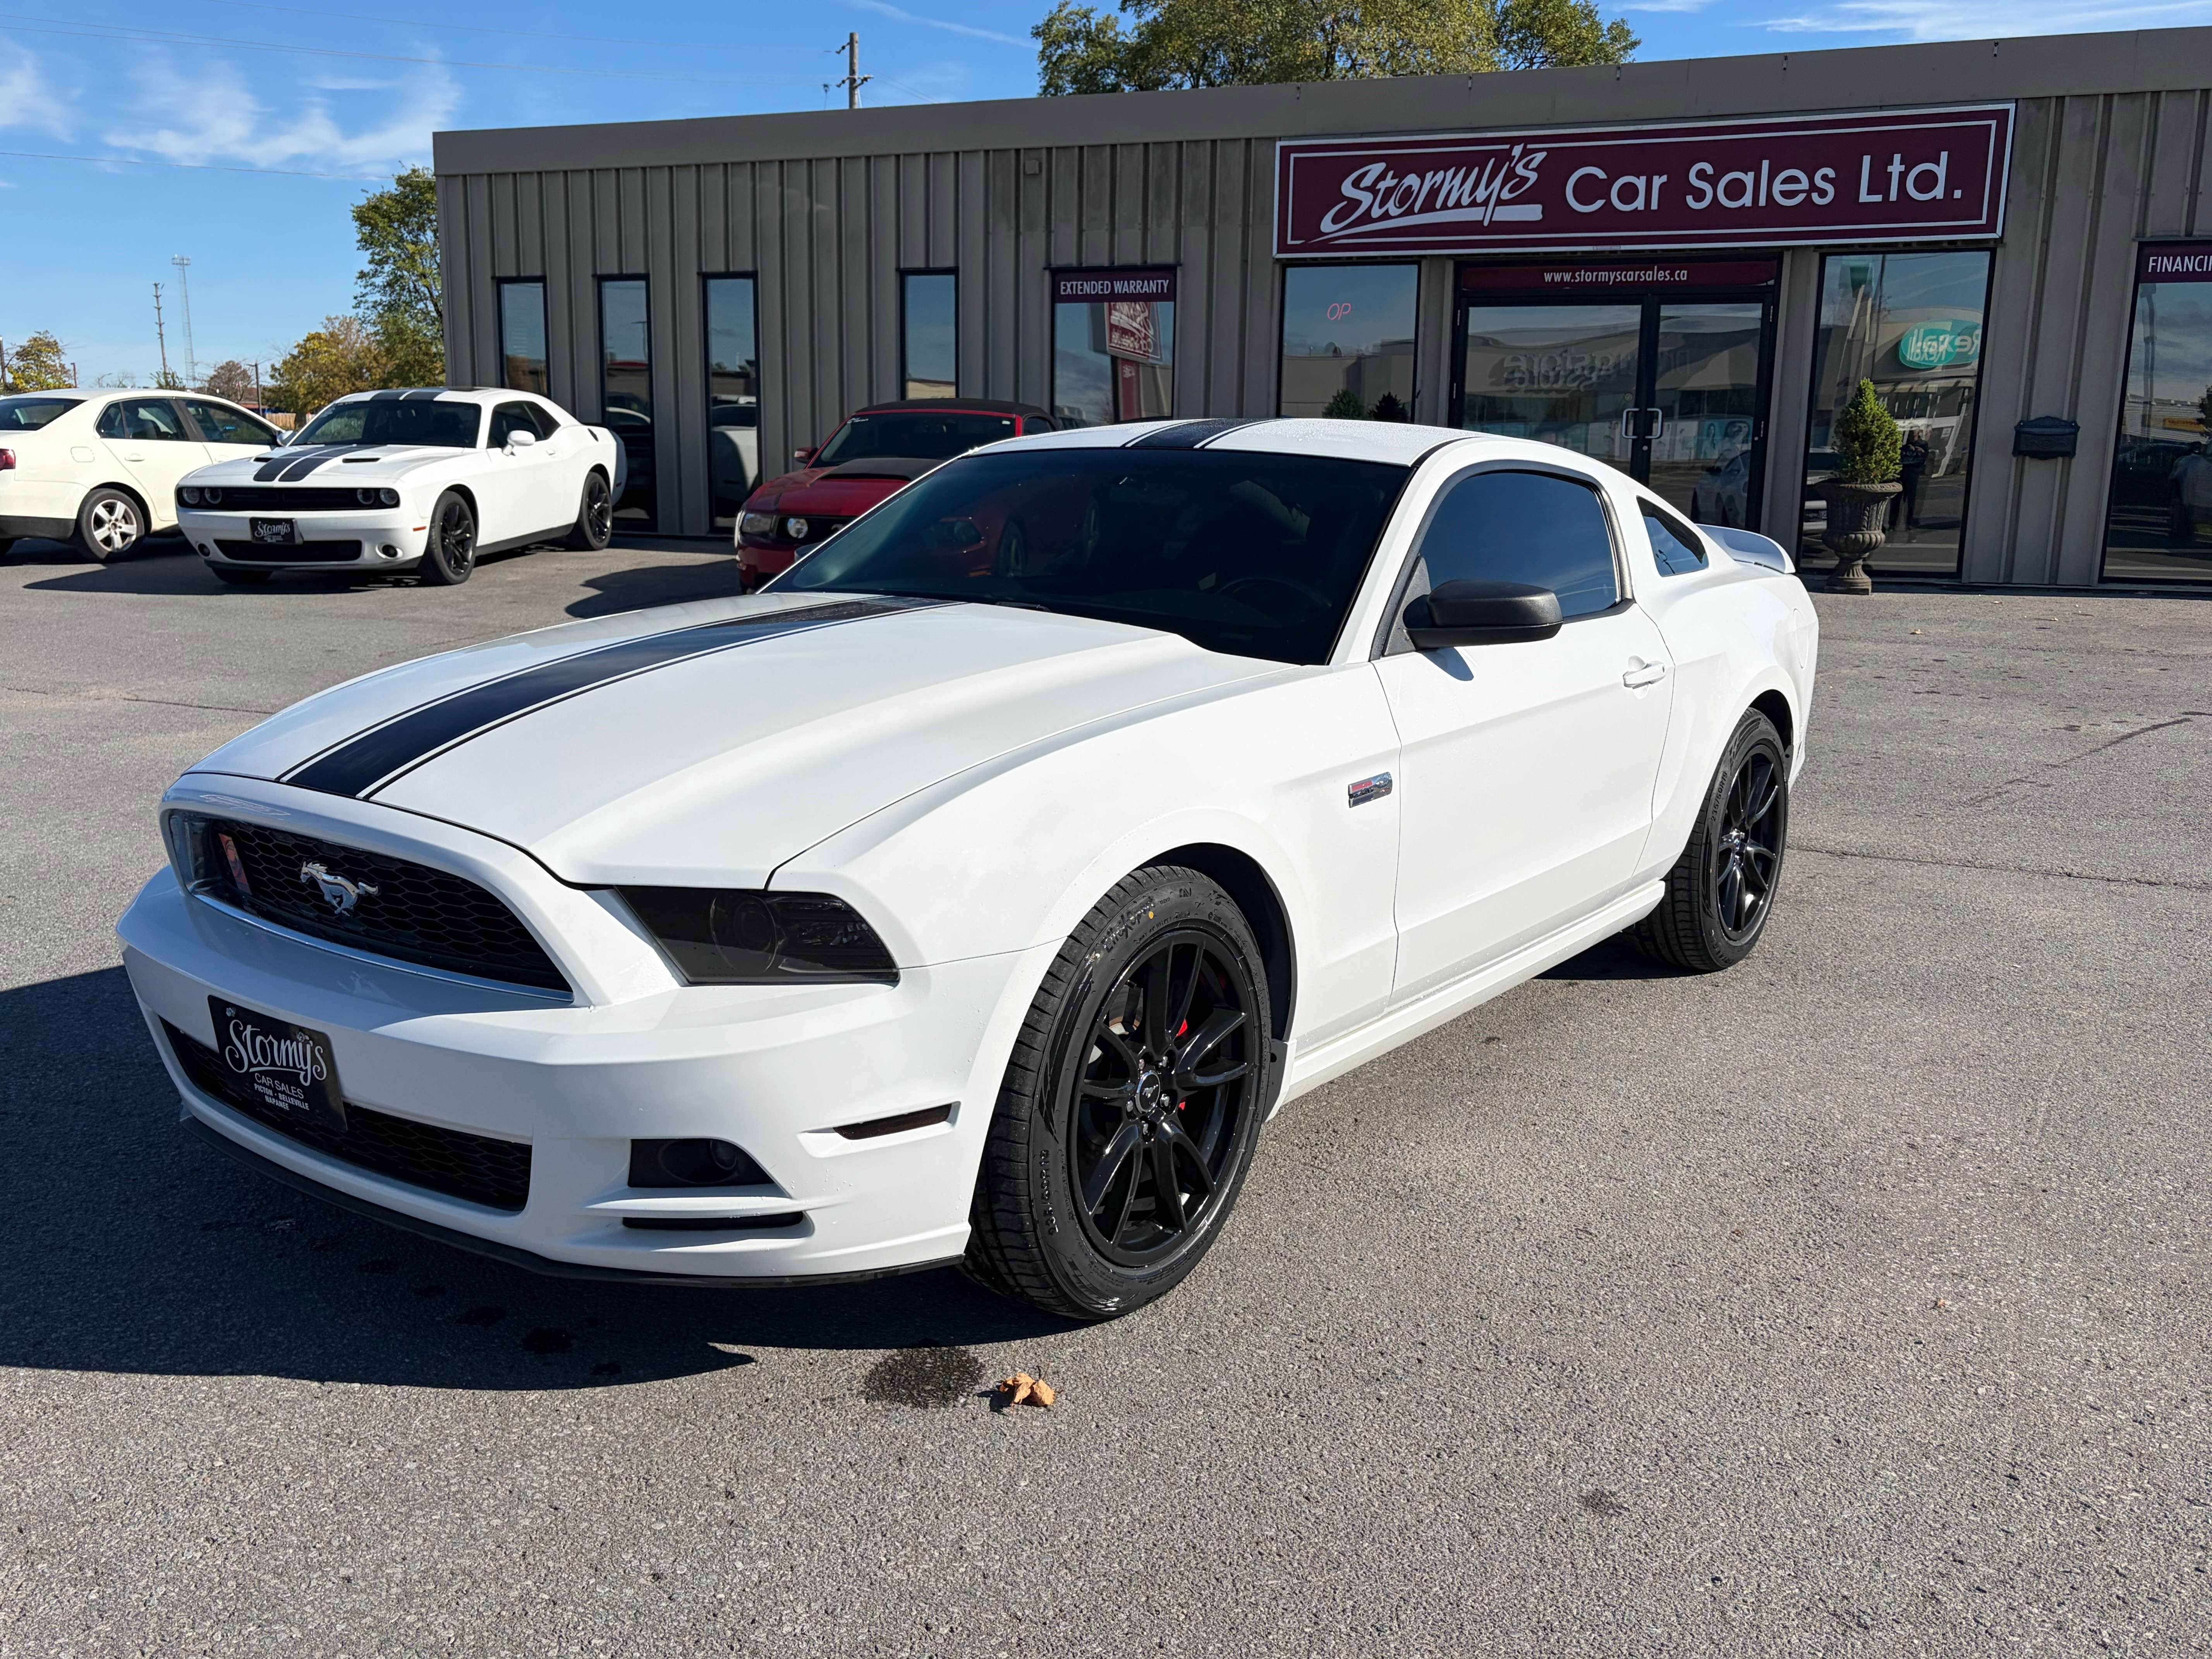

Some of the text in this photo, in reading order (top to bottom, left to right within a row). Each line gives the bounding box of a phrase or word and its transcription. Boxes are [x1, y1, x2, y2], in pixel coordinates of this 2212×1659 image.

[1320, 143, 1962, 227] Stormy's Car Sales Ltd.
[1060, 279, 1169, 295] EXTENDED WARRANTY
[1543, 265, 1688, 285] www.stormyscarsales.ca
[225, 1019, 327, 1086] Stormy's
[254, 1073, 304, 1099] CAR SALES
[254, 1083, 310, 1111] PICTON BELLEVILLE
[264, 1095, 290, 1111] NAPANEE
